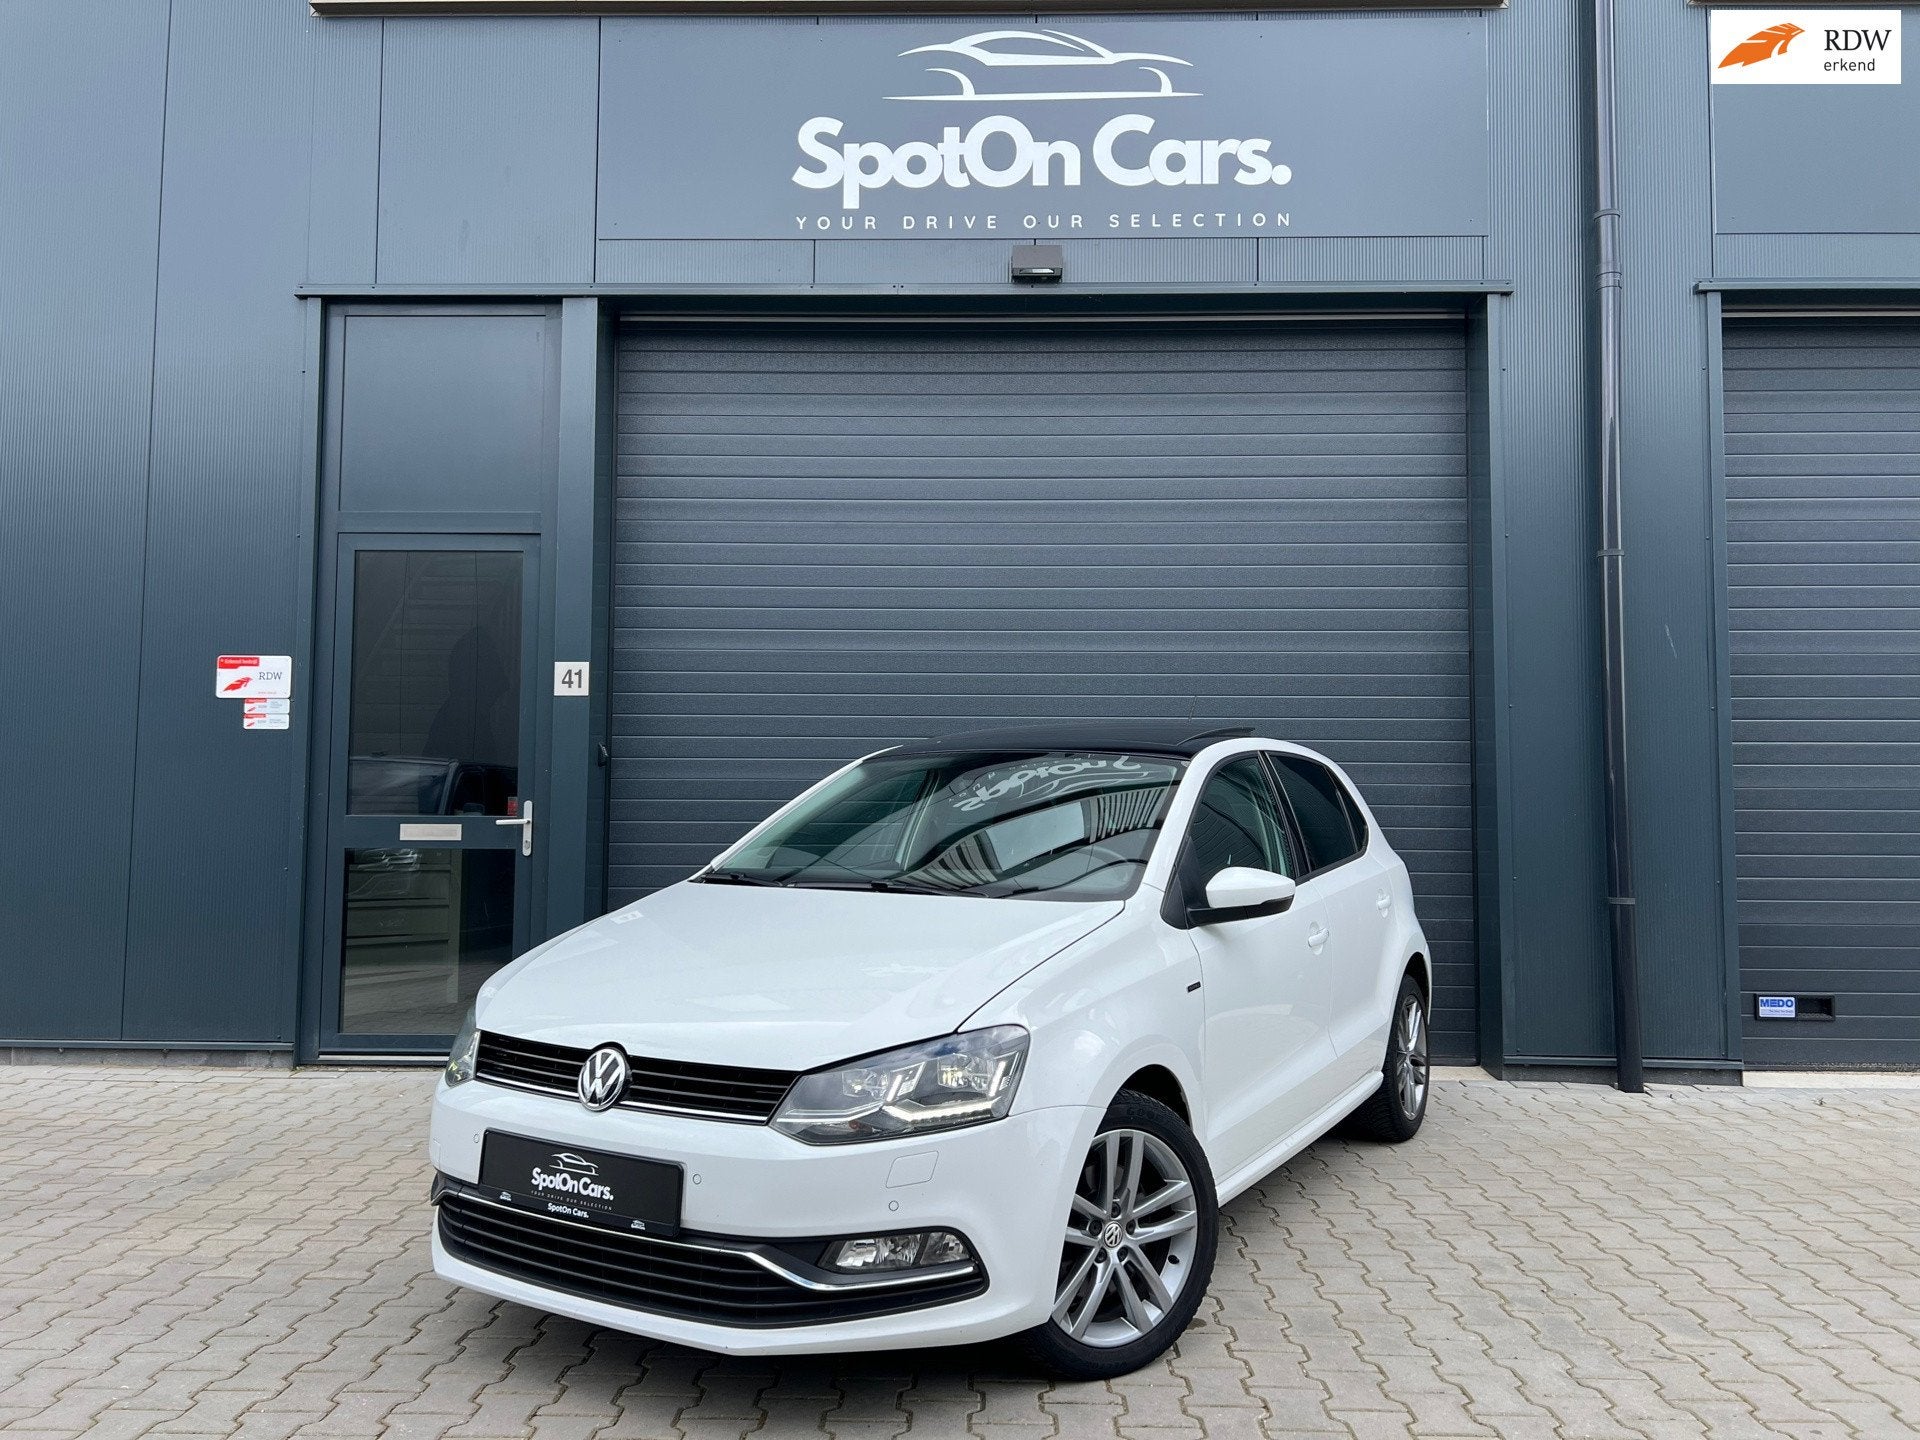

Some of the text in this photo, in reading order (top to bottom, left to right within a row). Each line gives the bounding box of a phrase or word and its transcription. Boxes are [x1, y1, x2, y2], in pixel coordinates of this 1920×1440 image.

[792, 113, 1292, 209] SpotOn Cars.
[796, 212, 1292, 230] YOUR DRIVE OUR SELECTION
[258, 672, 283, 680] RDW
[561, 669, 582, 688] 41
[1760, 998, 1794, 1008] MEDO
[531, 1167, 614, 1201] SpotOn Cars.
[547, 1202, 589, 1219] SpotOn Cars.
